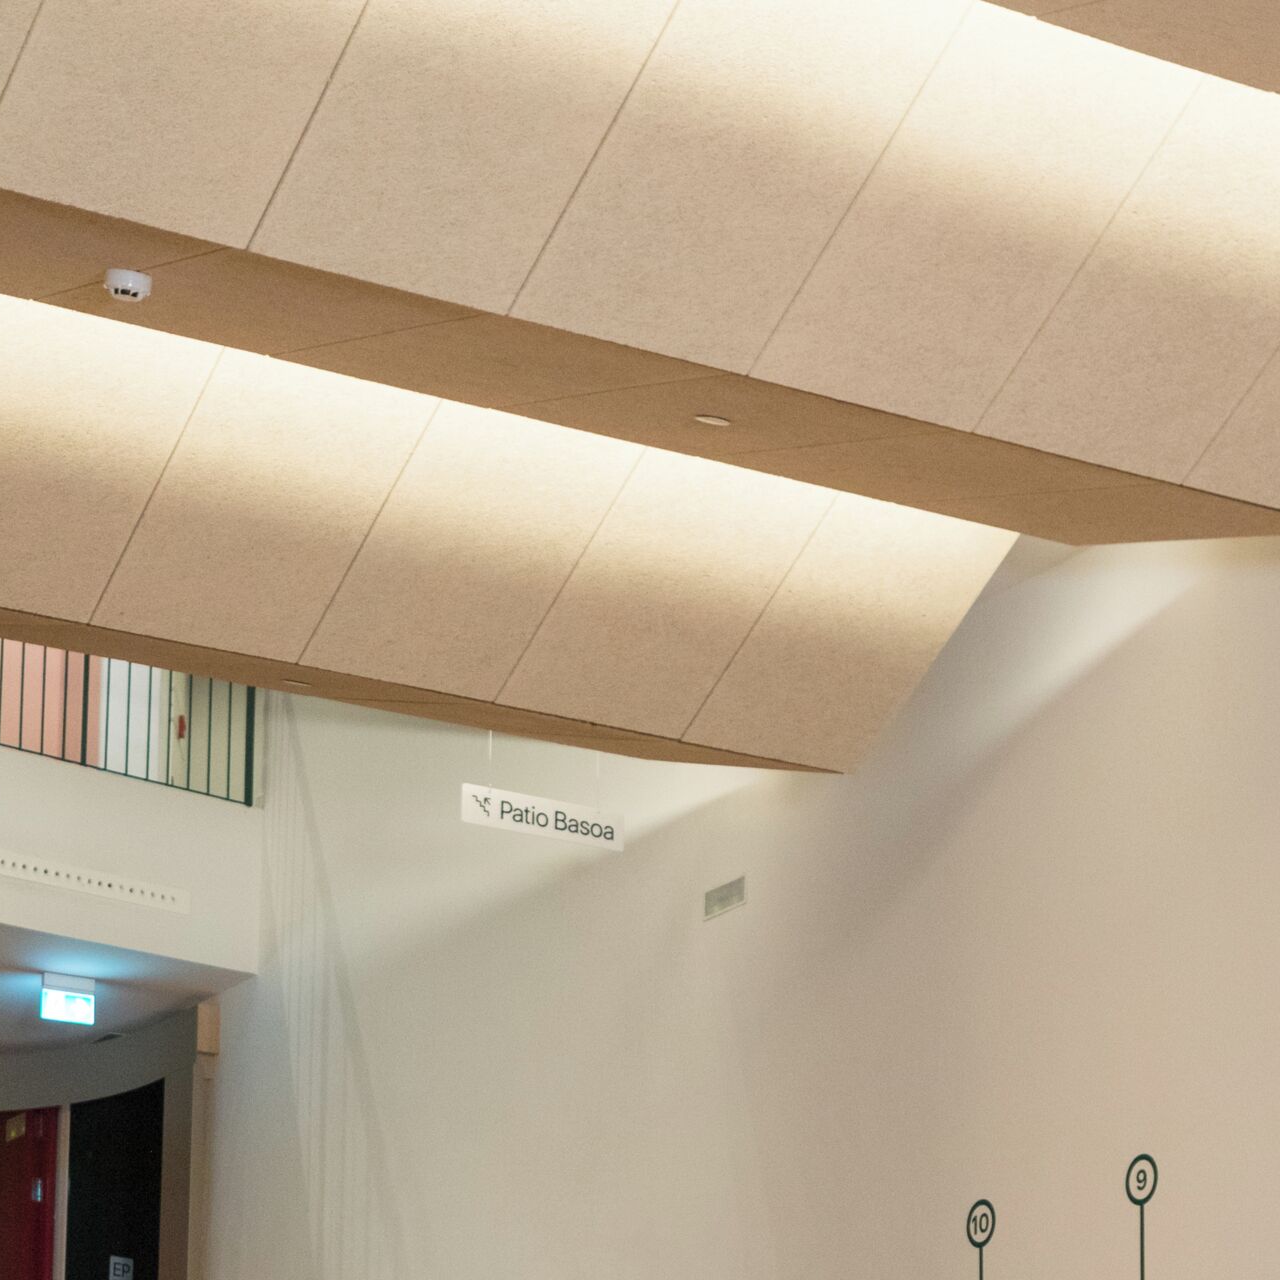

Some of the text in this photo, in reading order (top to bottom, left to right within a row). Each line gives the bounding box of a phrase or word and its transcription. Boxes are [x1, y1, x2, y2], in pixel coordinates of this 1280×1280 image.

[500, 799, 615, 841] Patio Basoa
[1135, 1169, 1148, 1191] 9
[971, 1212, 990, 1236] 10
[113, 1262, 131, 1278] EP
